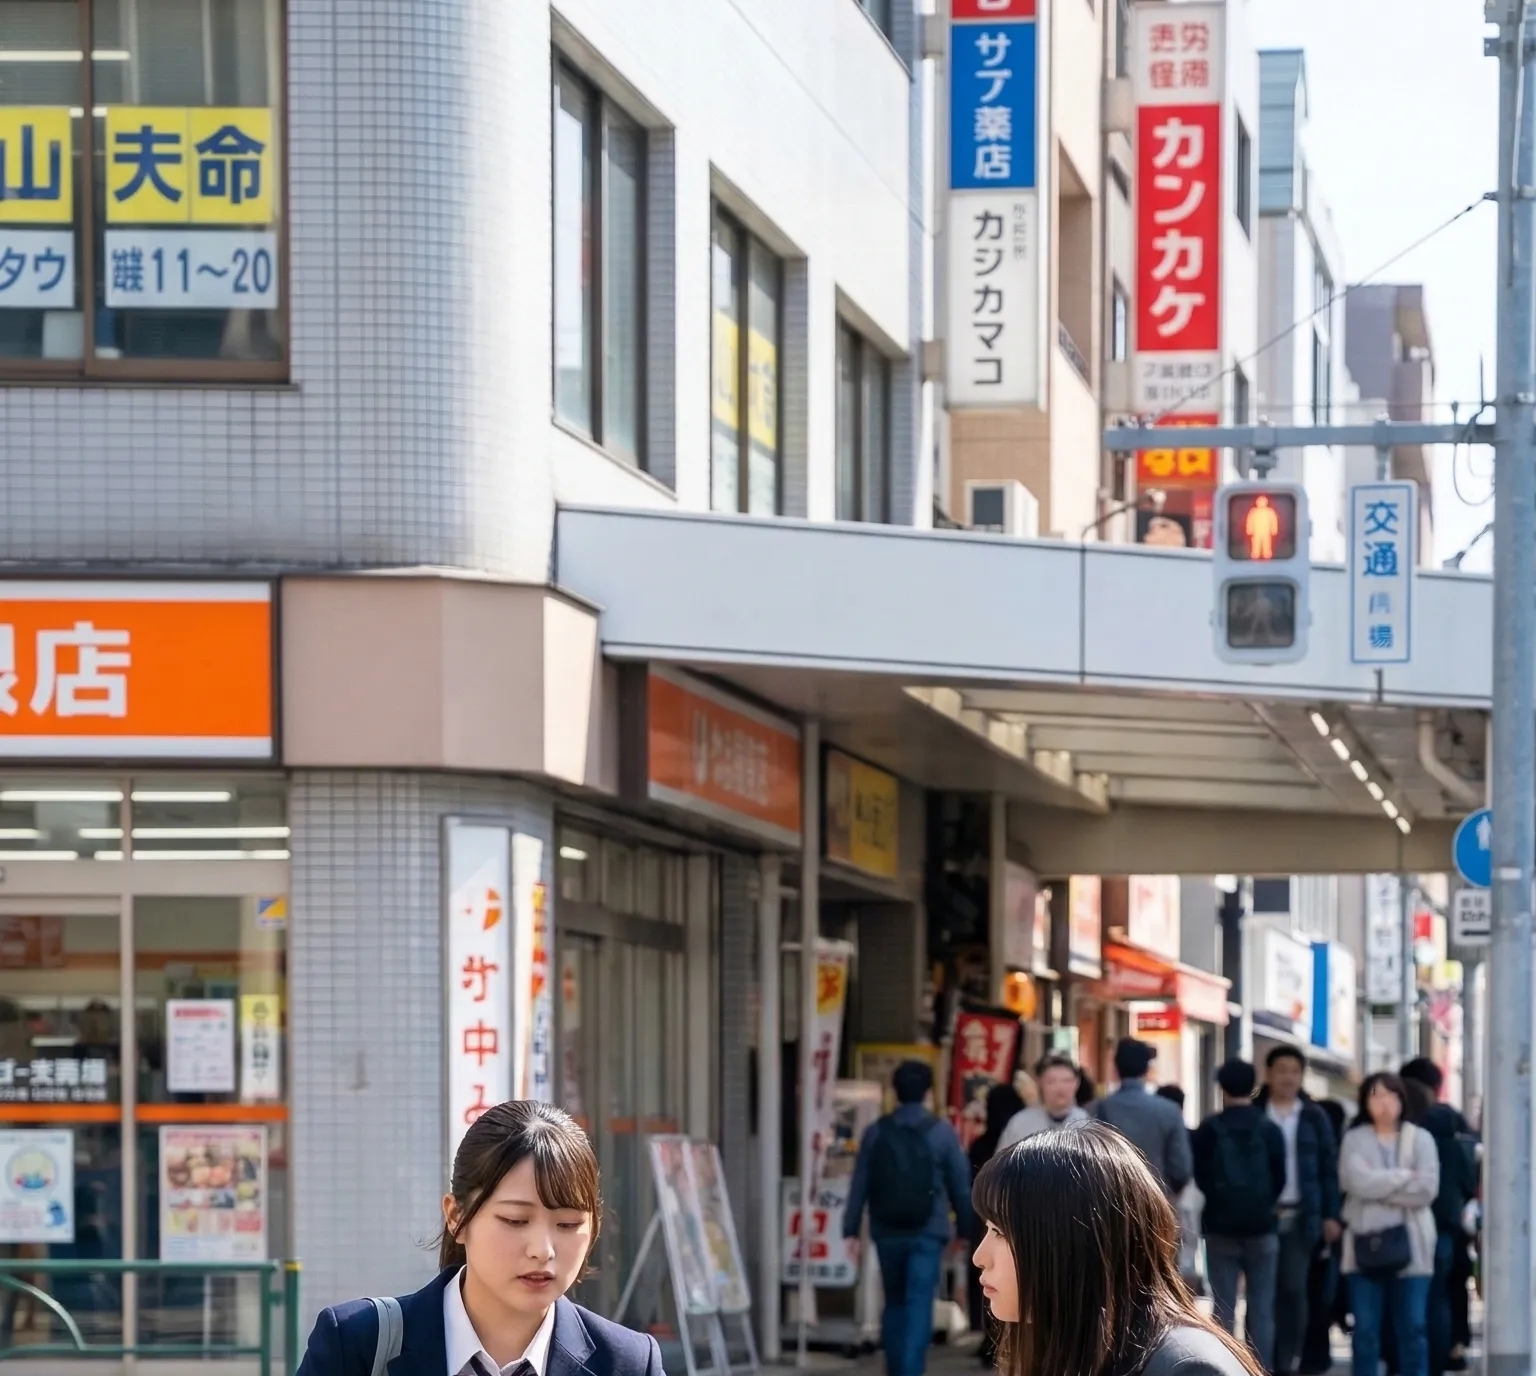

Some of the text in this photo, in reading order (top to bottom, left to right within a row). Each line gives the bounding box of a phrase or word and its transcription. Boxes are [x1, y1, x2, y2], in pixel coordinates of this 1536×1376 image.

[113, 125, 266, 205] 夫命
[1152, 117, 1207, 337] カンカケ
